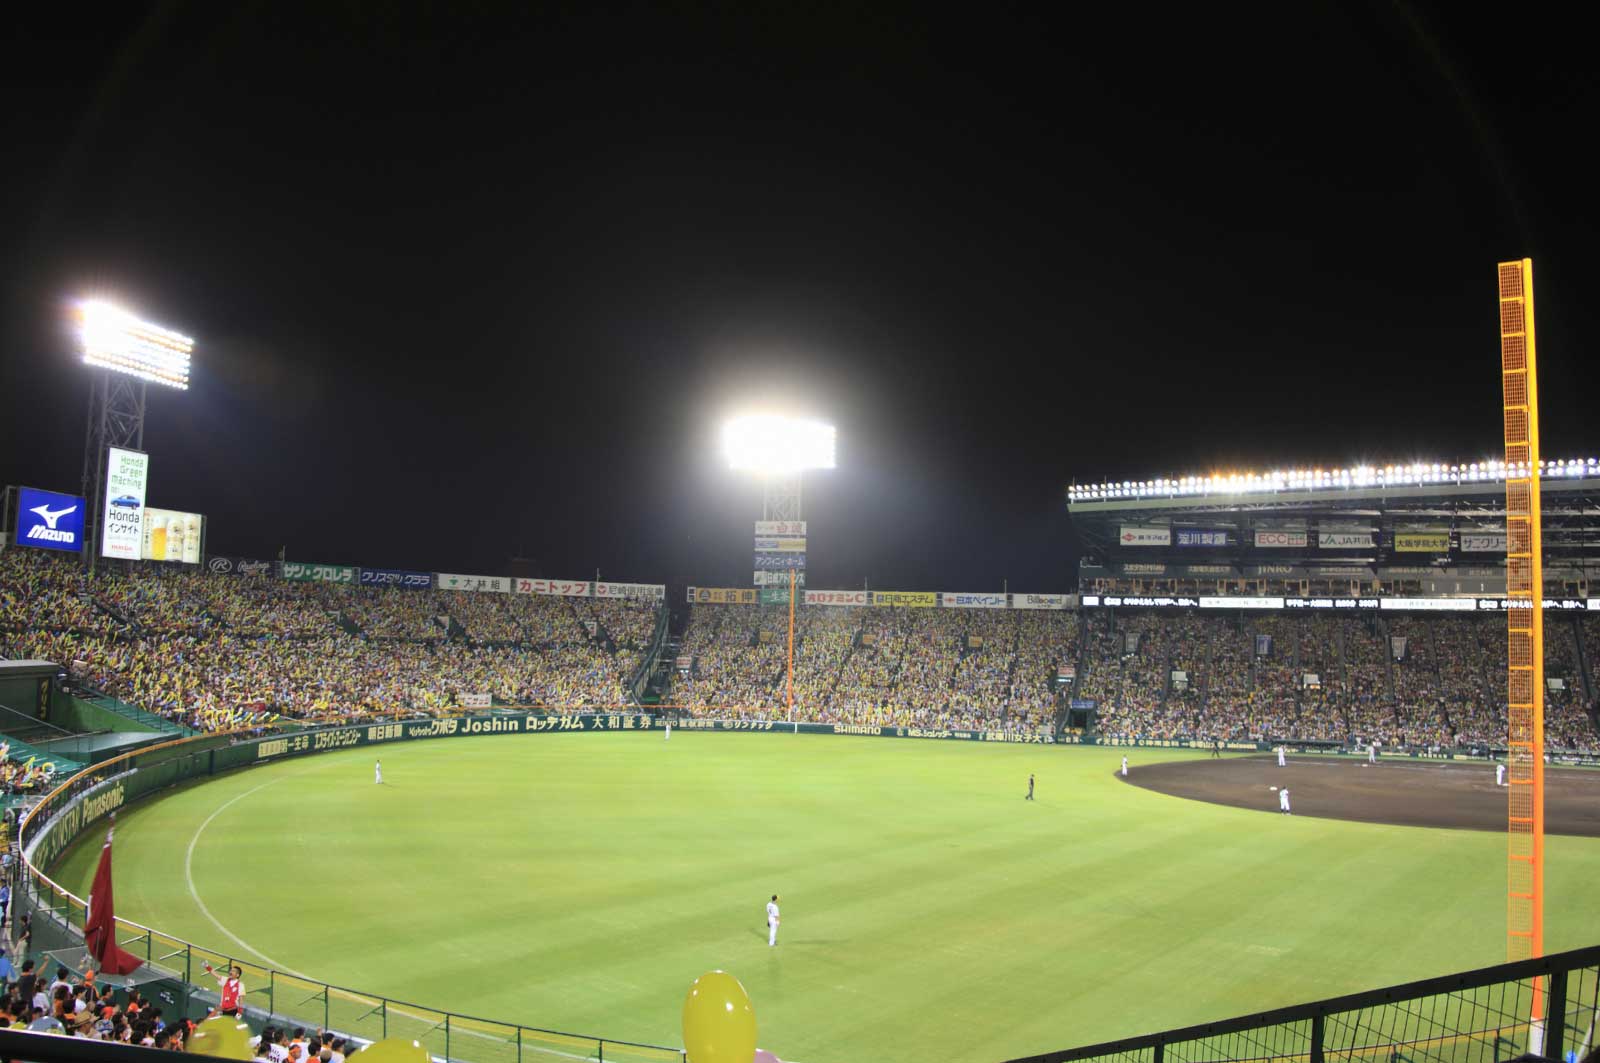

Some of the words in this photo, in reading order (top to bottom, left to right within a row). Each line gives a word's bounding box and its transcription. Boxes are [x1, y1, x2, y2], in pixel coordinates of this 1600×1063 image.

[109, 509, 140, 523] Honda
[108, 523, 138, 536] インサイト
[1258, 530, 1286, 544] ECC
[463, 577, 500, 590] 大林組
[519, 580, 588, 594] カニトップ
[956, 595, 1005, 605] 日本ペイント
[431, 719, 458, 734] クボタ
[461, 718, 518, 733] Joshin
[525, 716, 584, 730] ロッテガム
[592, 715, 652, 729] 大和証券
[833, 725, 881, 735] SHIMANO
[82, 781, 124, 828] Panasonic
